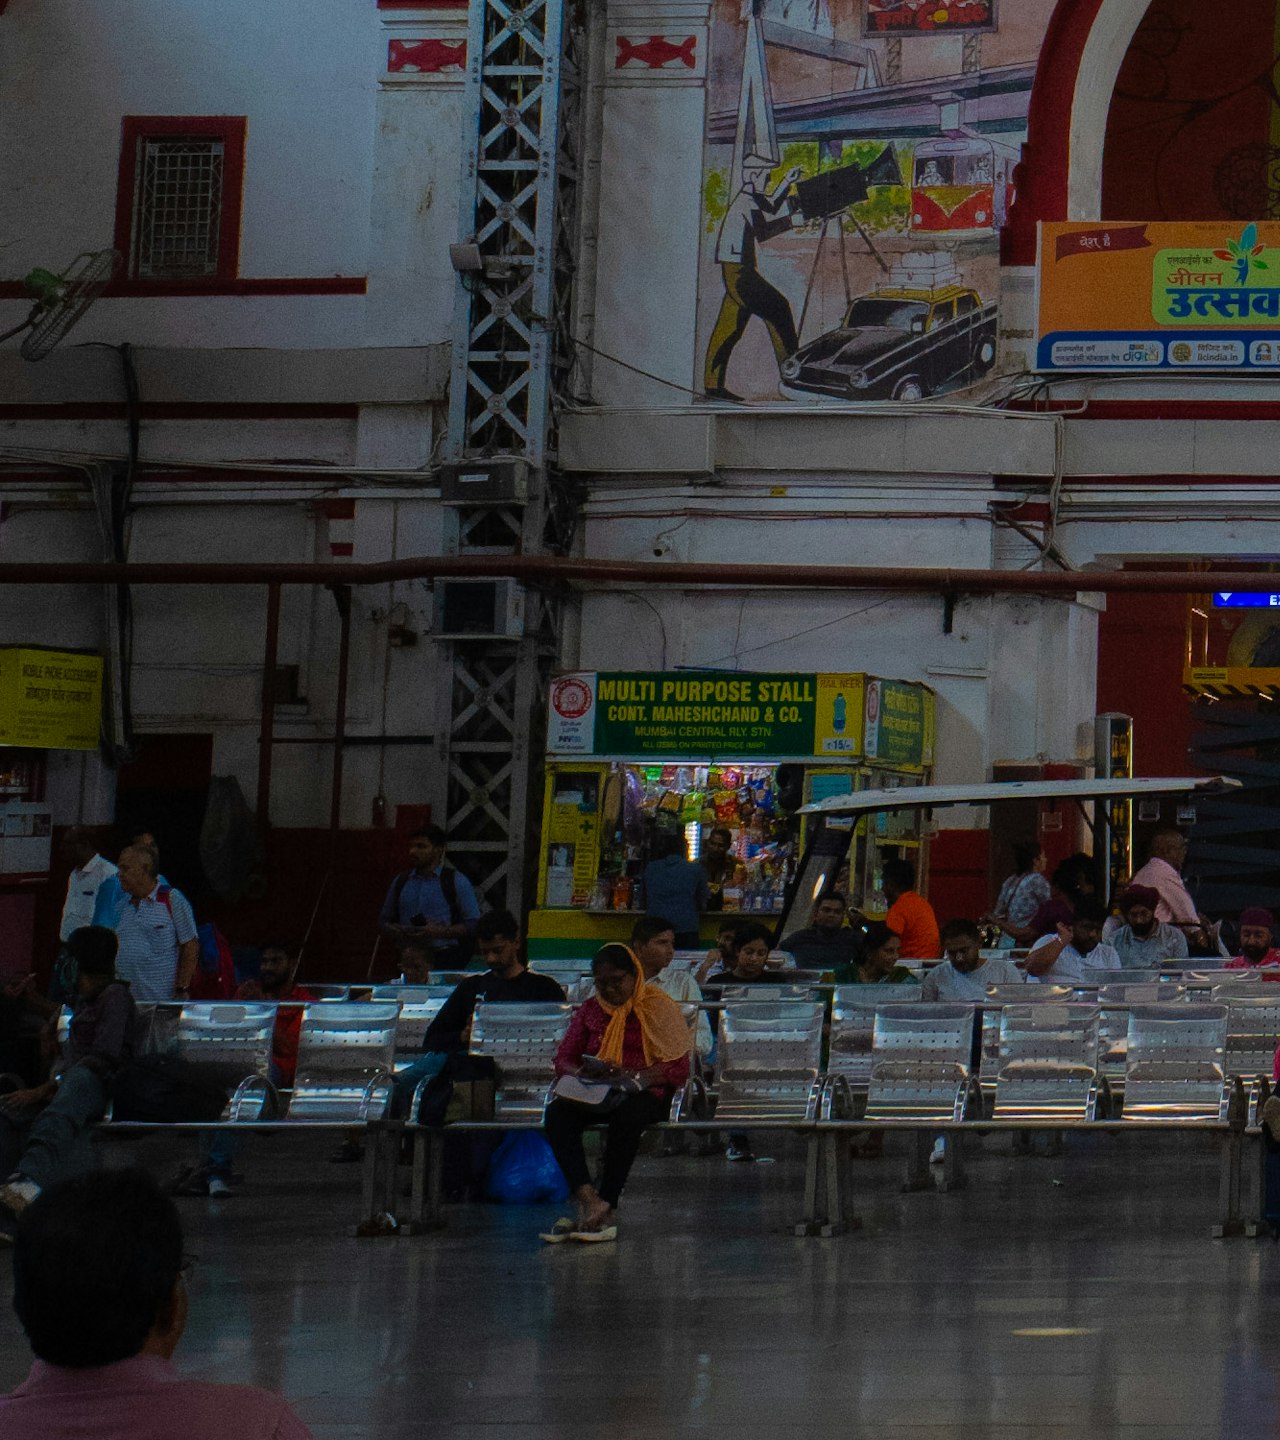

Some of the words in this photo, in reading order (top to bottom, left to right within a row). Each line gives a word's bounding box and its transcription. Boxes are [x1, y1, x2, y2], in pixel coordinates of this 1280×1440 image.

[1167, 268, 1223, 286] जीवन
[1197, 353, 1238, 362] licindia.in
[598, 680, 655, 702] MULTI
[662, 681, 751, 702] PURPOSE
[758, 681, 814, 702] STALL
[608, 706, 648, 722] CONT.
[652, 706, 759, 722] MAHESHCHAND
[764, 706, 775, 722] &
[779, 707, 802, 722] CO.
[634, 726, 676, 736] MUMBAI
[680, 726, 727, 736] CENTRAL
[751, 726, 772, 736] STN.
[680, 741, 690, 749] ON
[692, 741, 722, 749] PRINTED
[724, 741, 744, 749] PRICE
